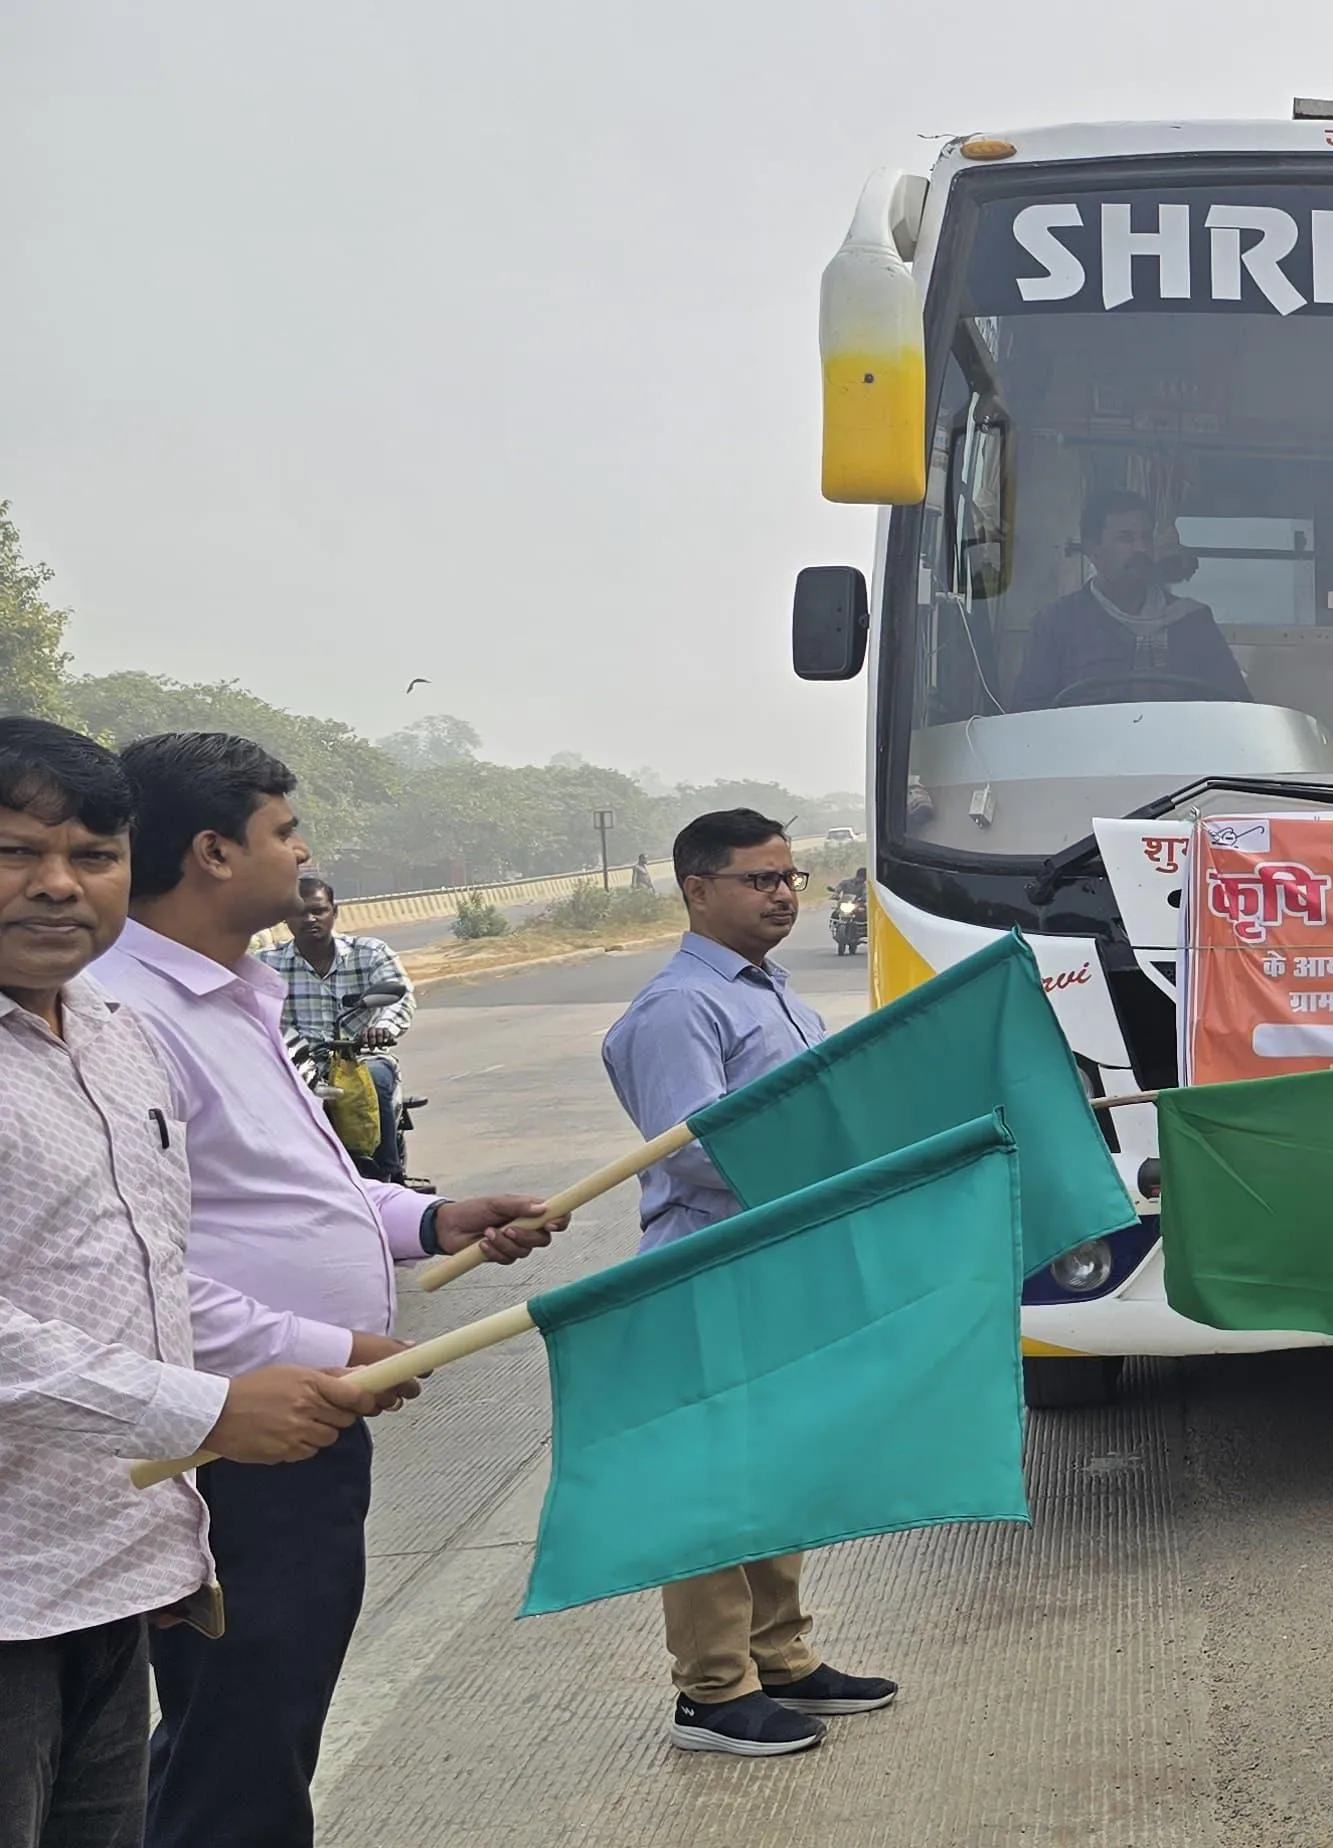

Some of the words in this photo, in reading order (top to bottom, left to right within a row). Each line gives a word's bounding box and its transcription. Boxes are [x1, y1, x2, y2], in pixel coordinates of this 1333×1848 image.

[1141, 836, 1189, 873] शु
[1208, 861, 1331, 944] कृषि
[1262, 949, 1287, 978] के
